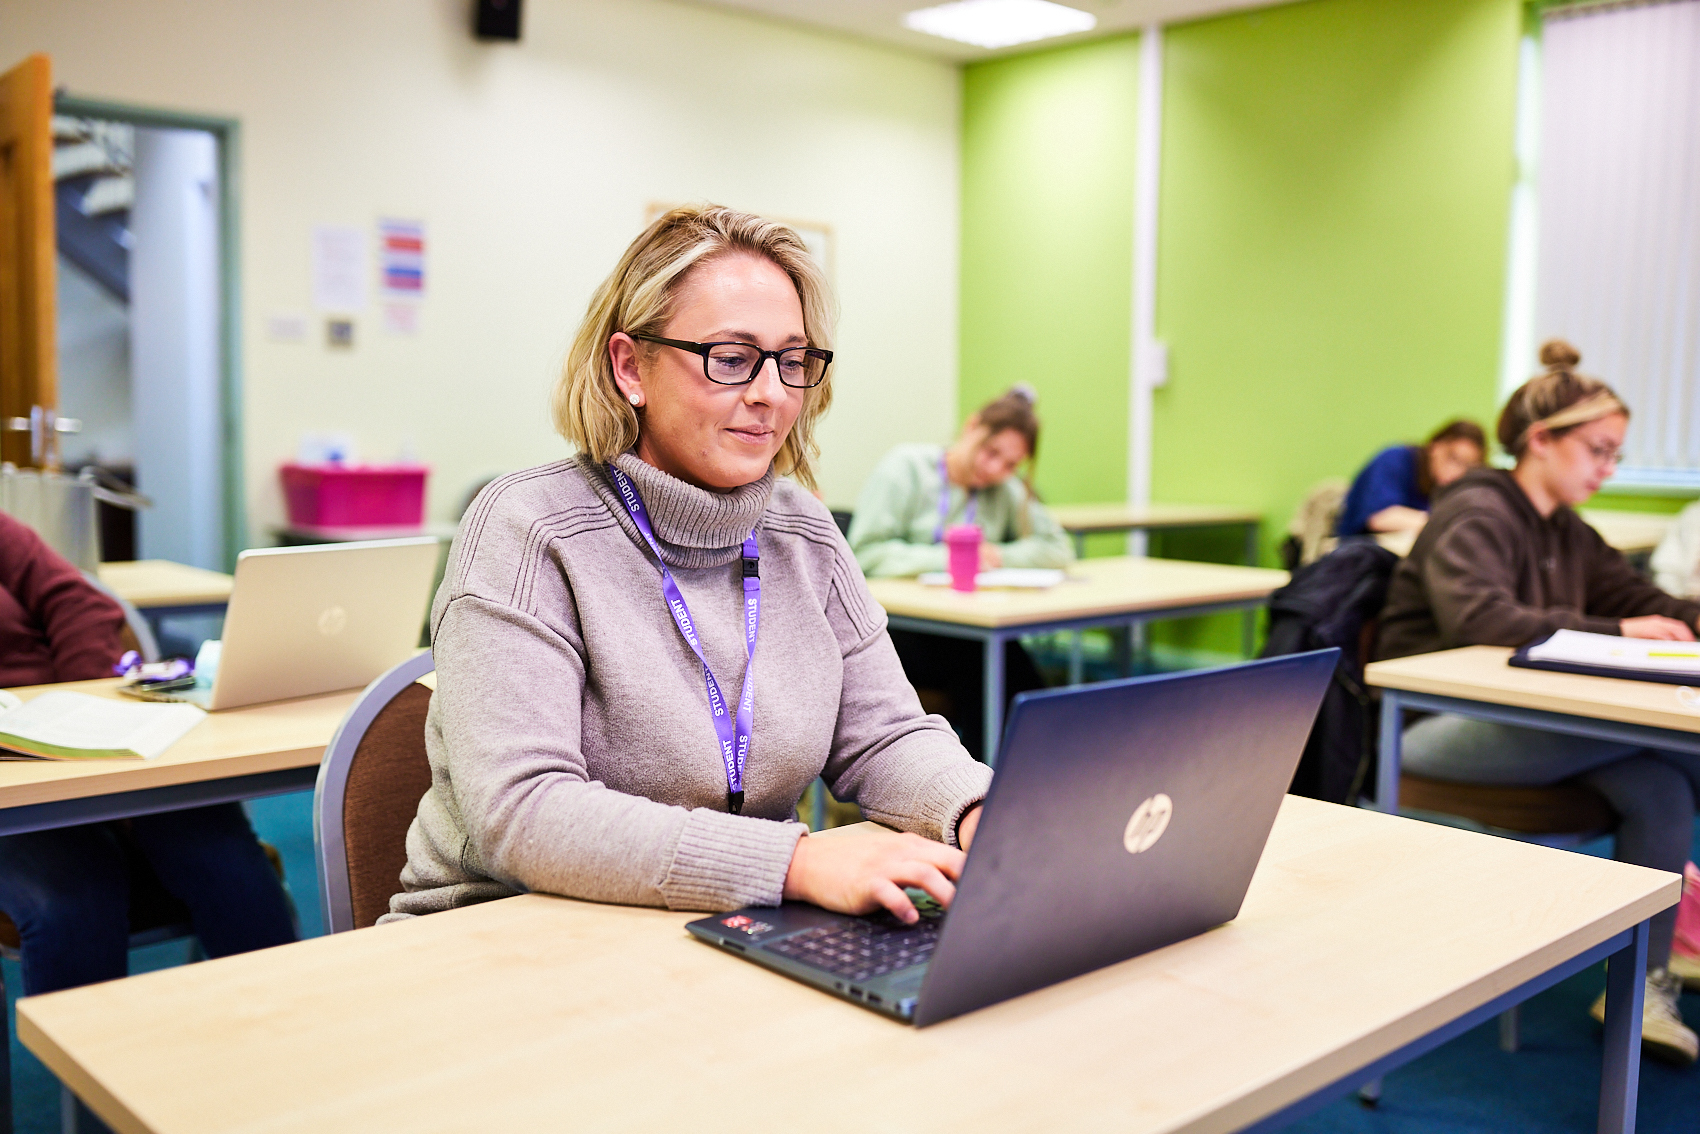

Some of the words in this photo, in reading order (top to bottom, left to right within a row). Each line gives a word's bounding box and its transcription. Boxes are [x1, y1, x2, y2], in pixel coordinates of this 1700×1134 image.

[613, 468, 640, 512] STUDENT
[670, 599, 698, 646] STUDENT
[747, 598, 758, 643] STUDENT
[704, 667, 724, 717] STUDENT
